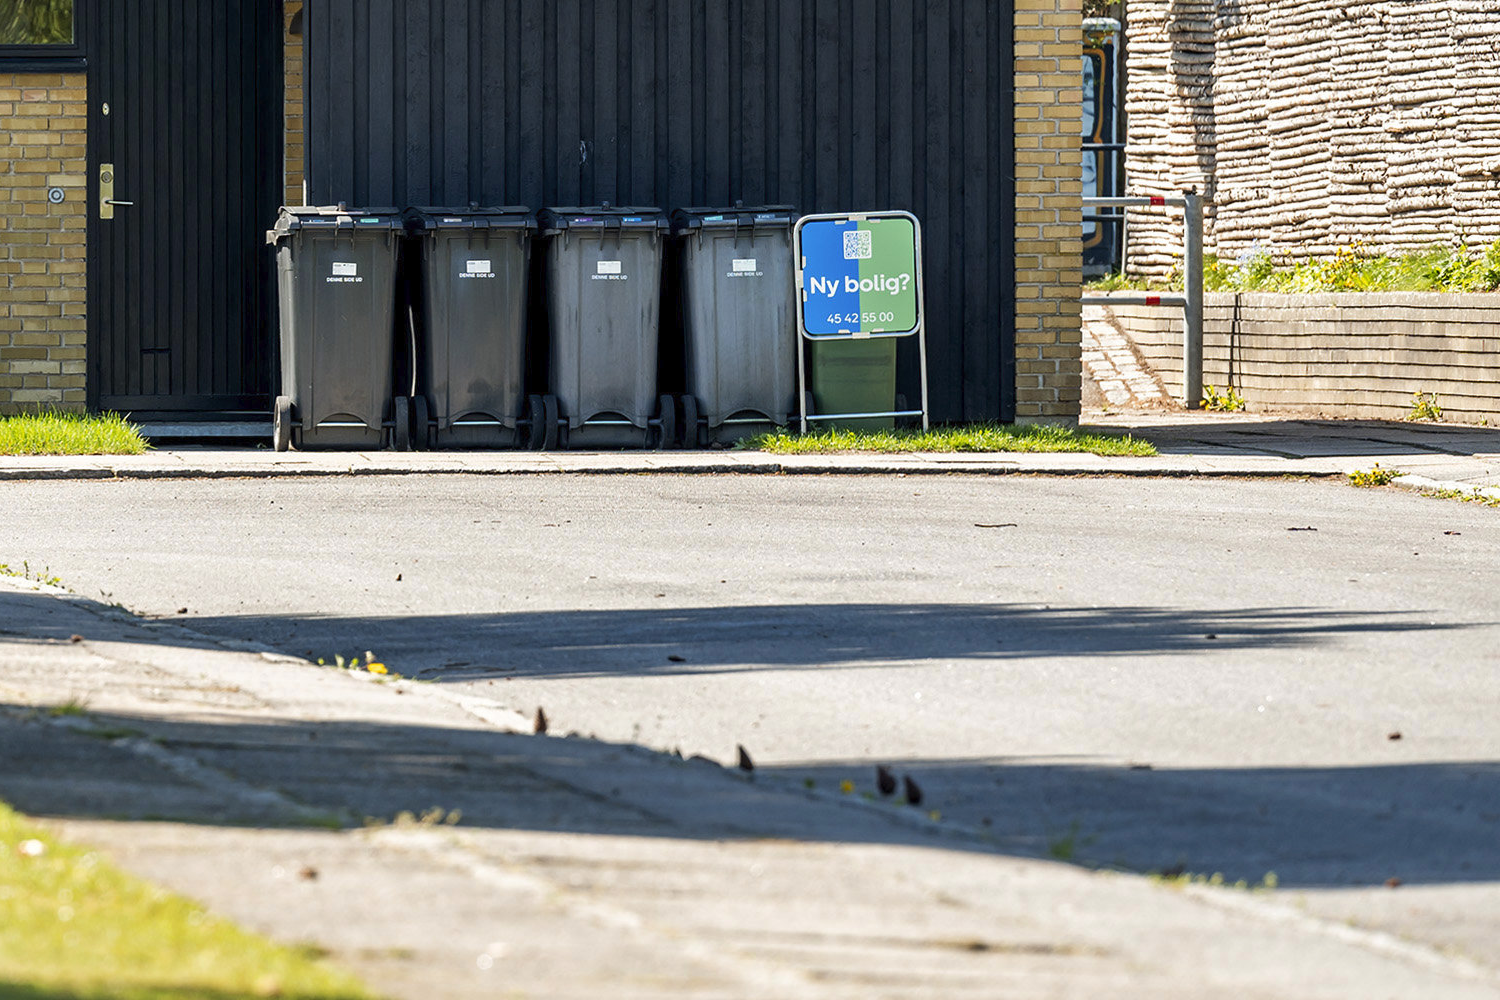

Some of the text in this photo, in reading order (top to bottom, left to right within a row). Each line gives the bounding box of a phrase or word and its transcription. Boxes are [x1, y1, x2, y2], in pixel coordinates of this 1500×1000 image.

[810, 273, 910, 298] Ny bolig?
[826, 312, 894, 324] 45 42 55 00
